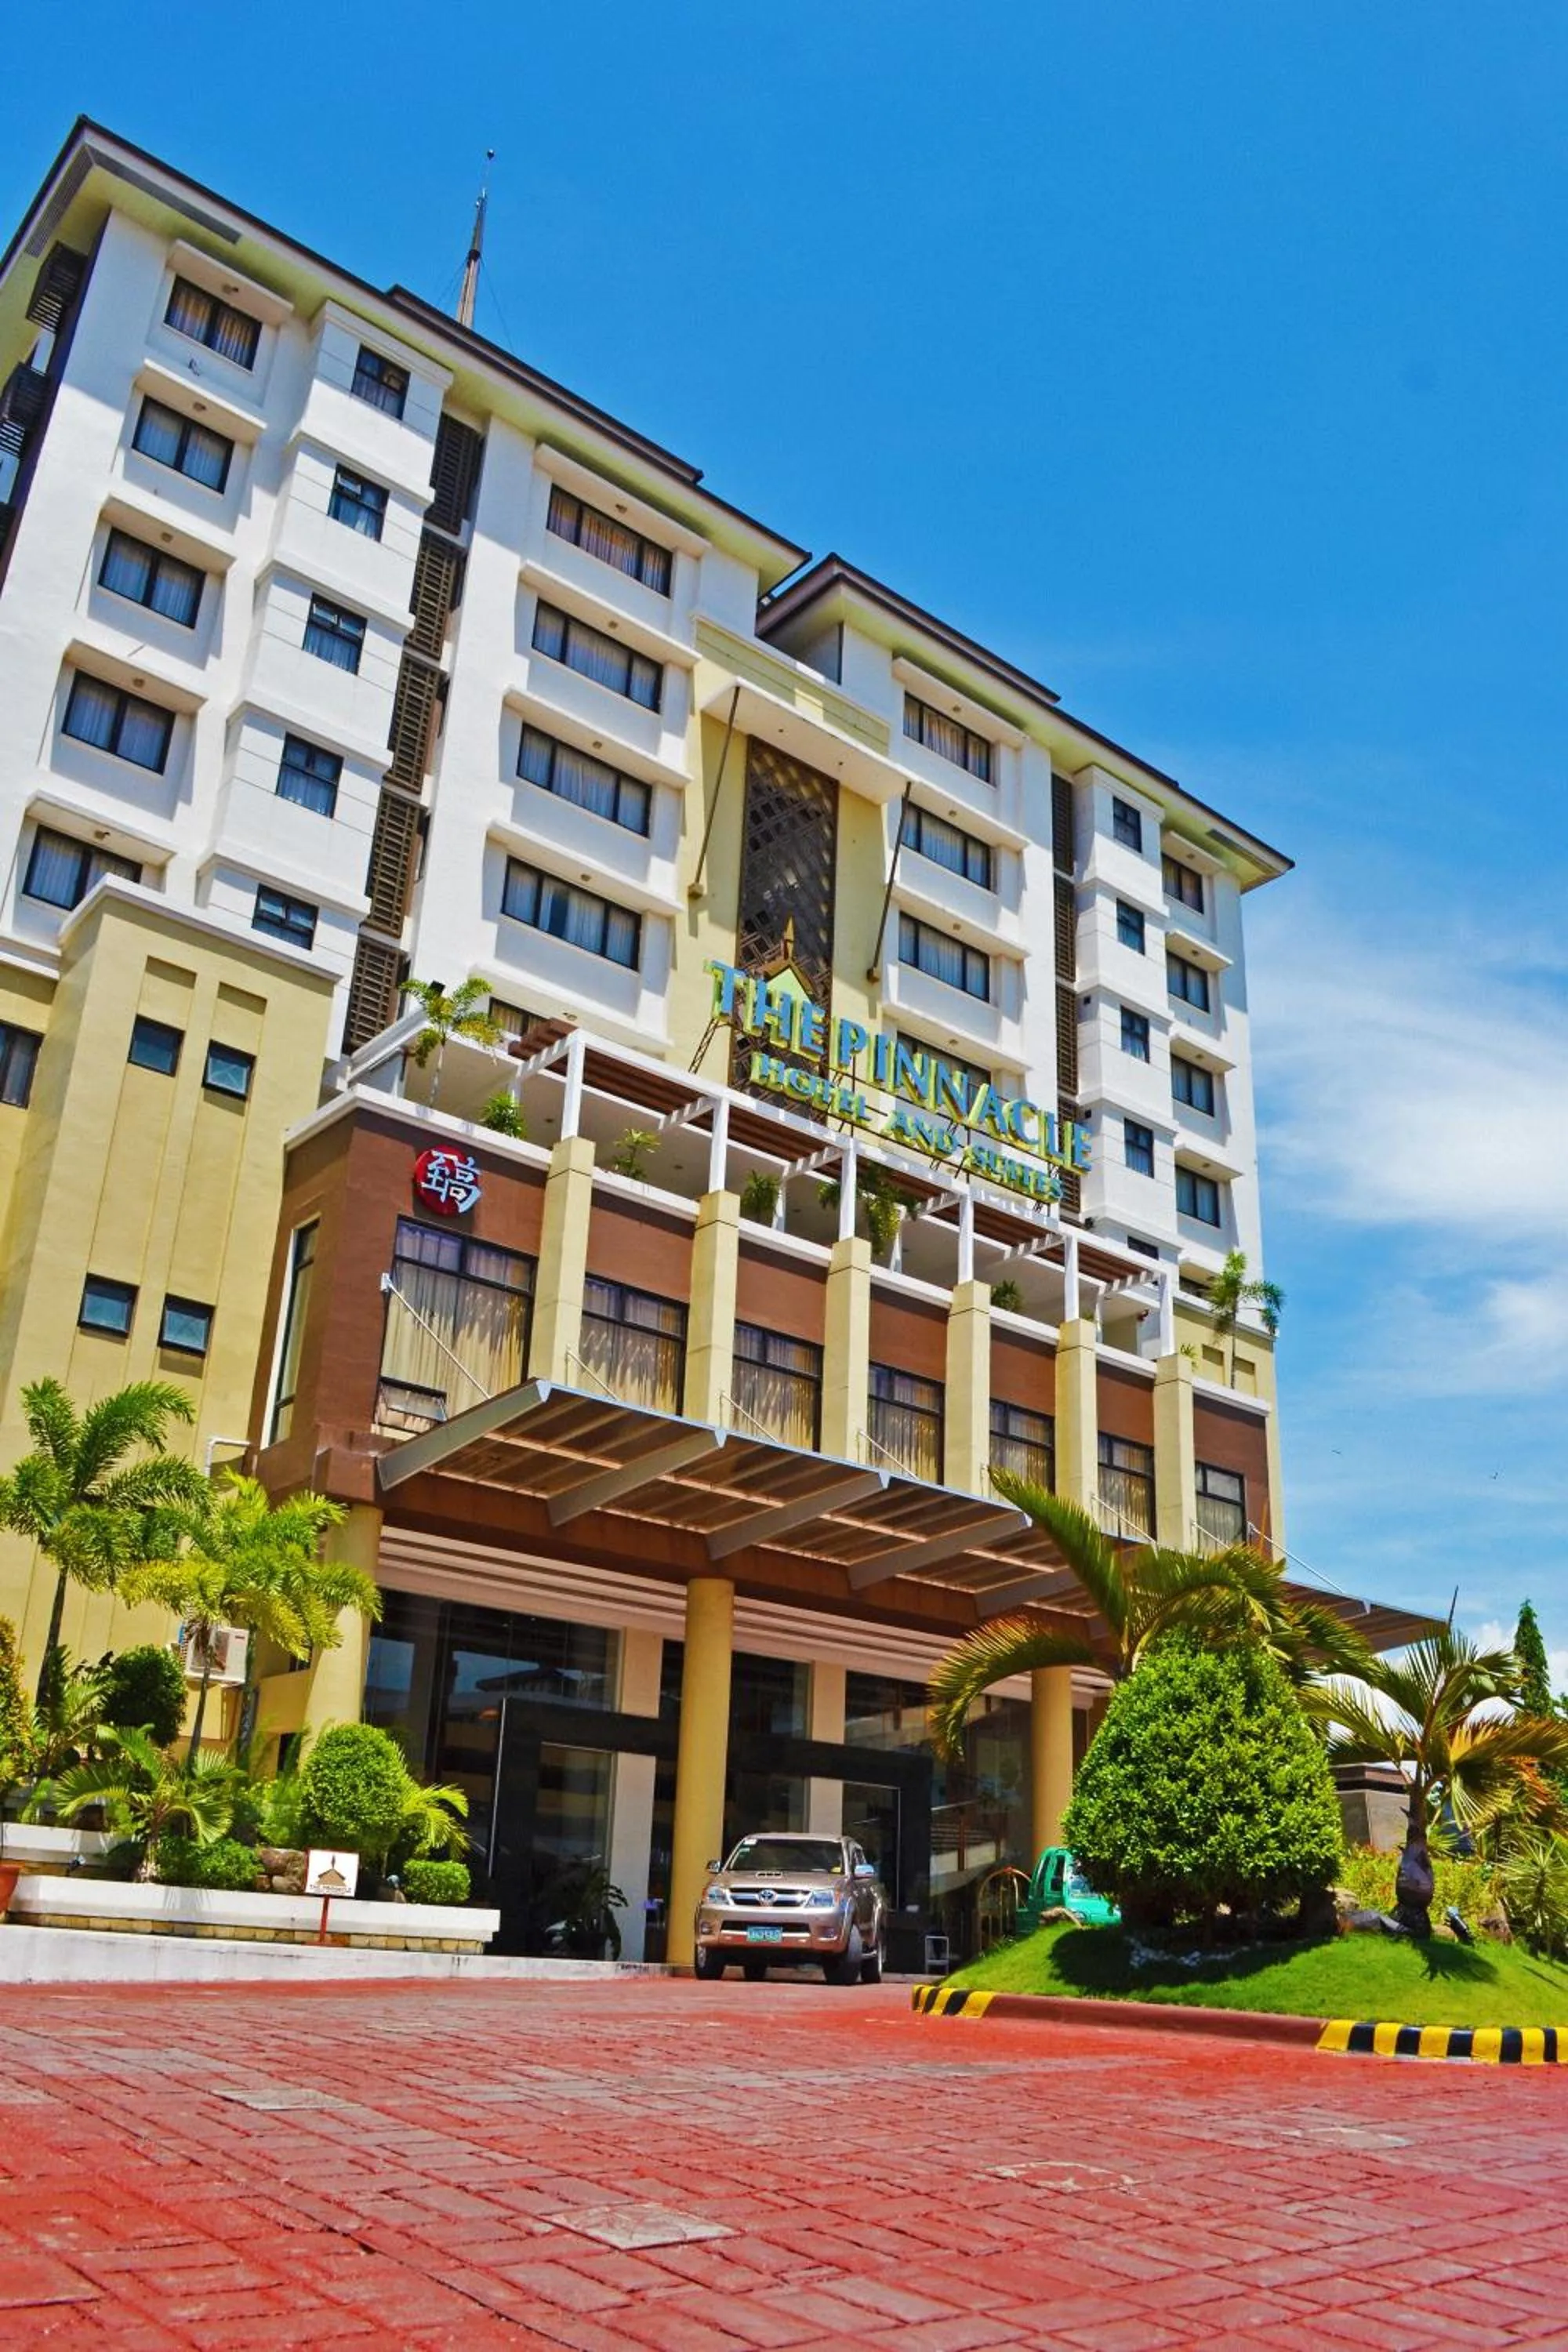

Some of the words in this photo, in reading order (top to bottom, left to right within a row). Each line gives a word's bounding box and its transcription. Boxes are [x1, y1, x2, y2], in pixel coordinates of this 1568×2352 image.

[702, 959, 826, 1063] THE
[829, 1017, 1093, 1177] PINNACLE
[750, 1051, 872, 1128] HOTEL
[880, 1109, 960, 1160] AND
[962, 1142, 1064, 1205] SUITES
